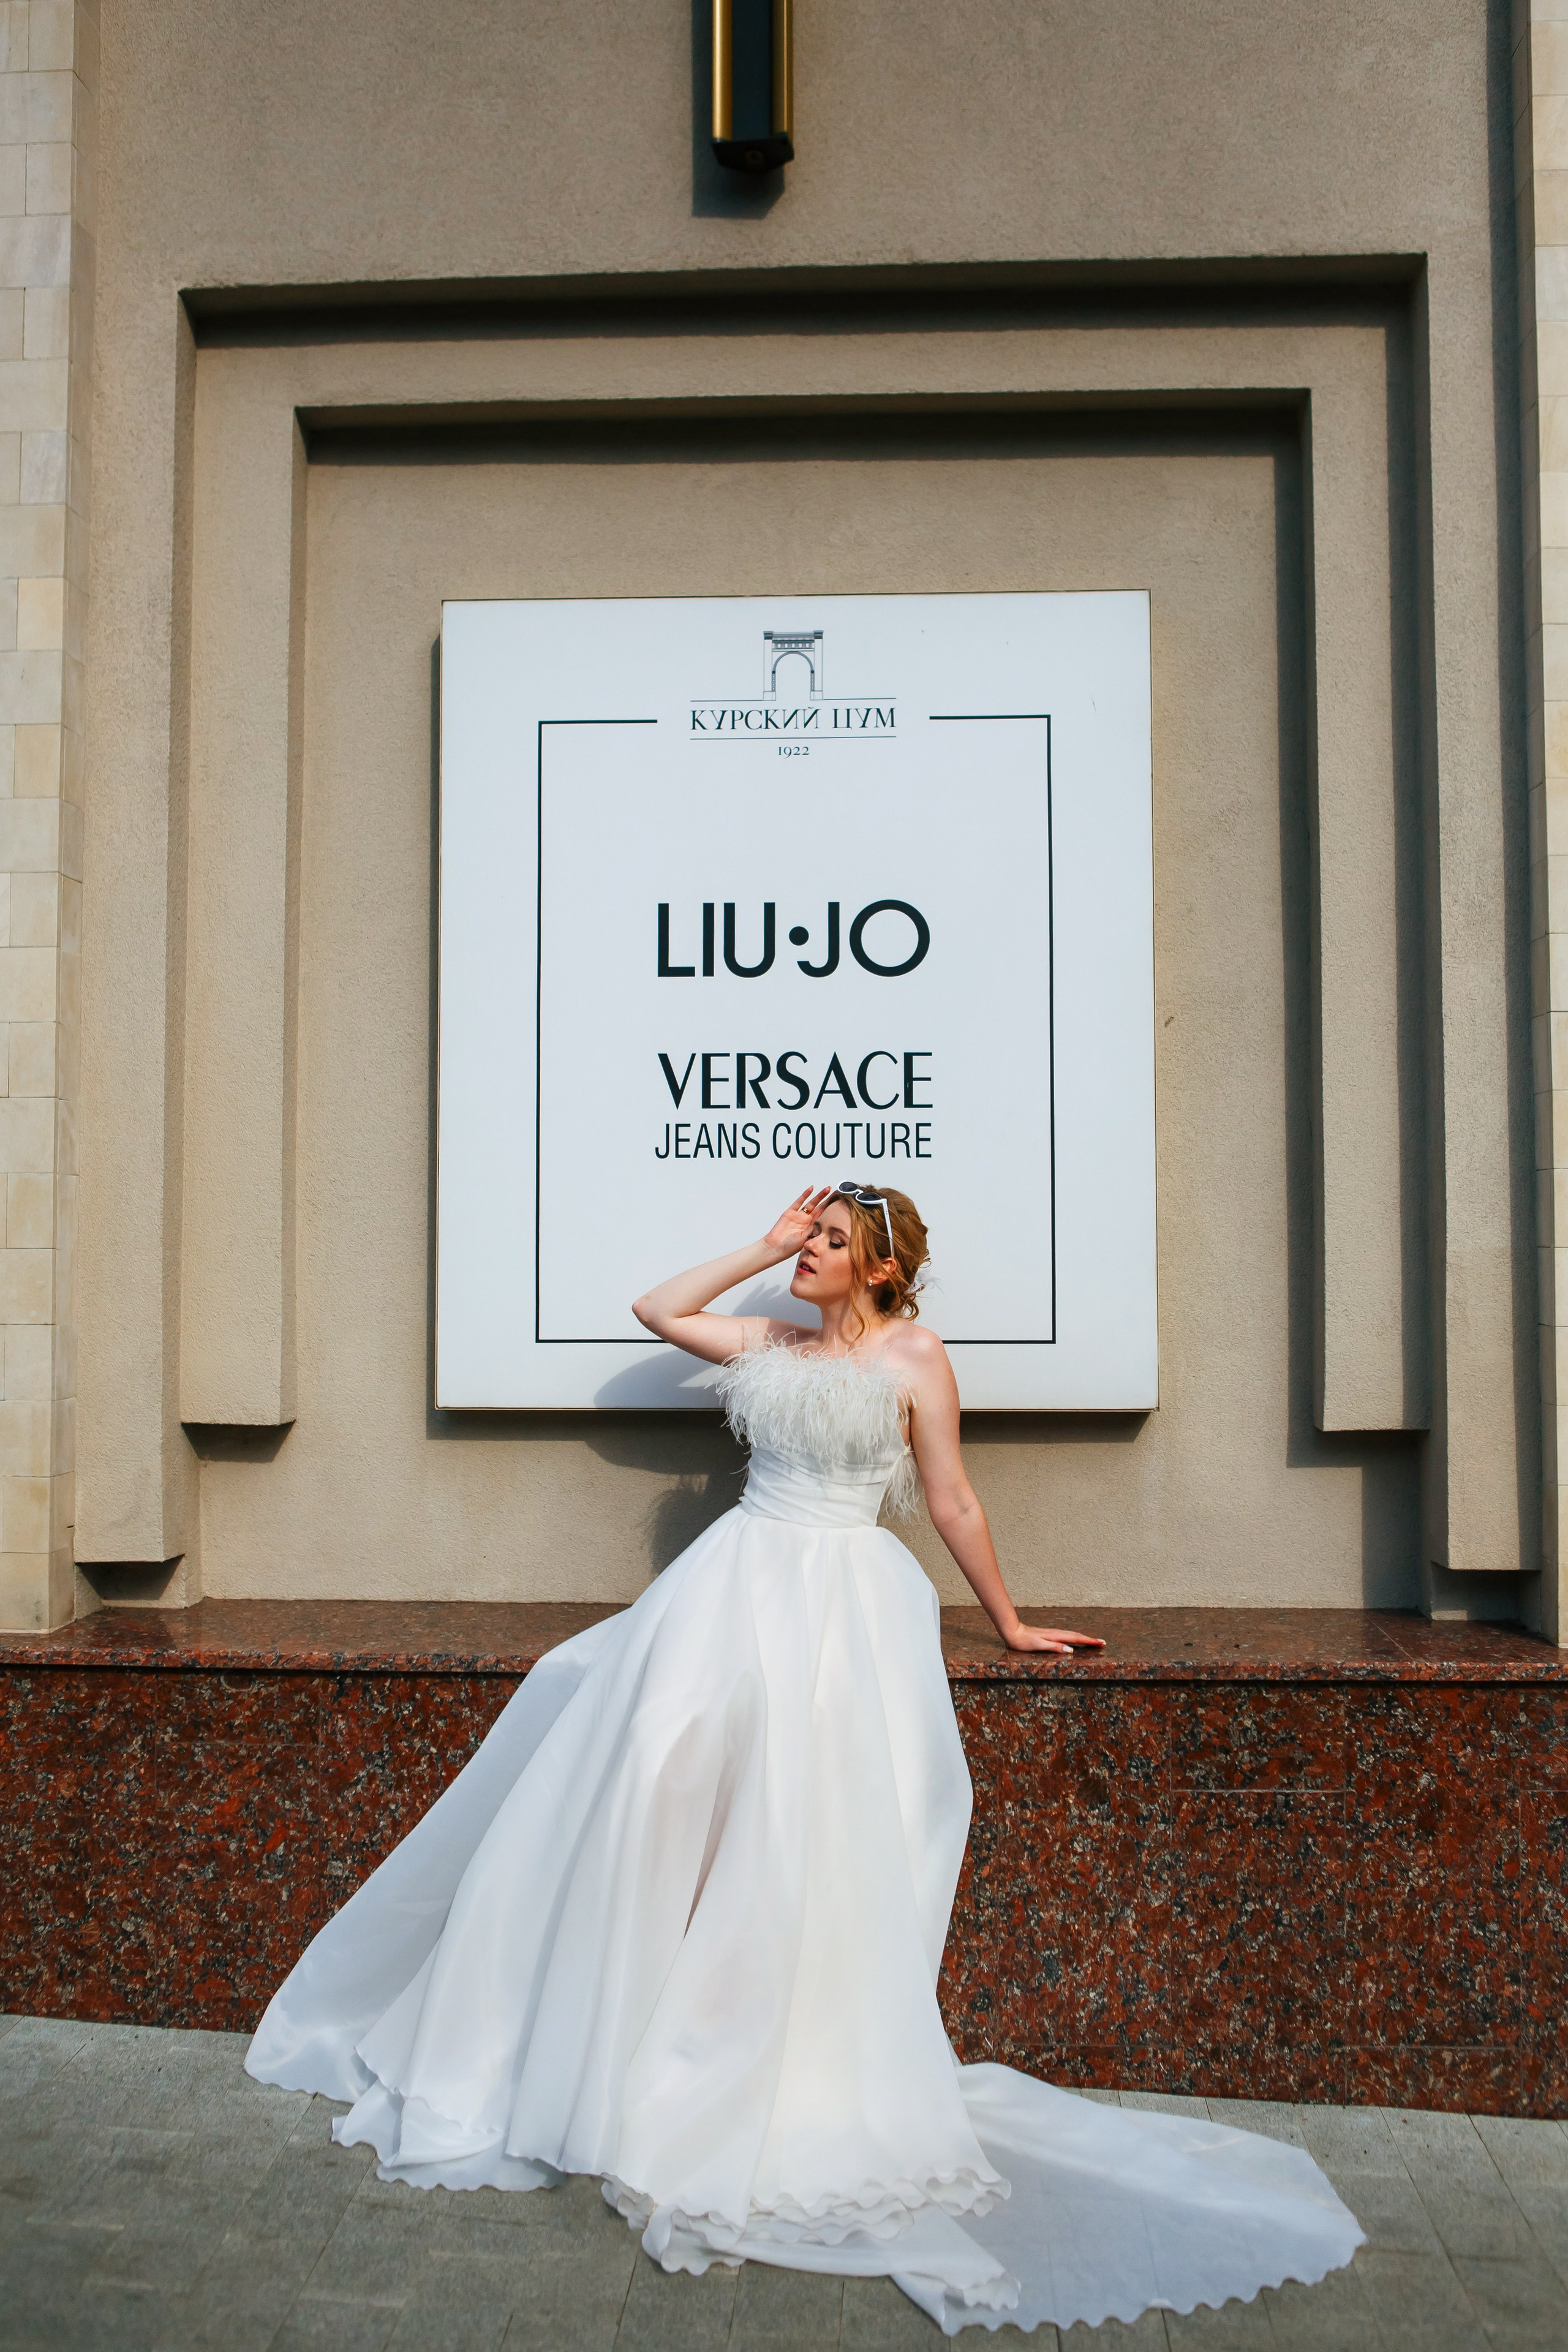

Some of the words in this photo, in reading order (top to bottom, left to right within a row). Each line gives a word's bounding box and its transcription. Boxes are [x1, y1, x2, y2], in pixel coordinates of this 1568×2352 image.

[690, 706, 821, 730] КУРСКИЙ
[832, 708, 897, 731] ЦУМ
[778, 746, 809, 759] 1922
[658, 1051, 933, 1110] VERSACE
[655, 1123, 761, 1159] JEANS
[773, 1123, 932, 1159] COUTURE
